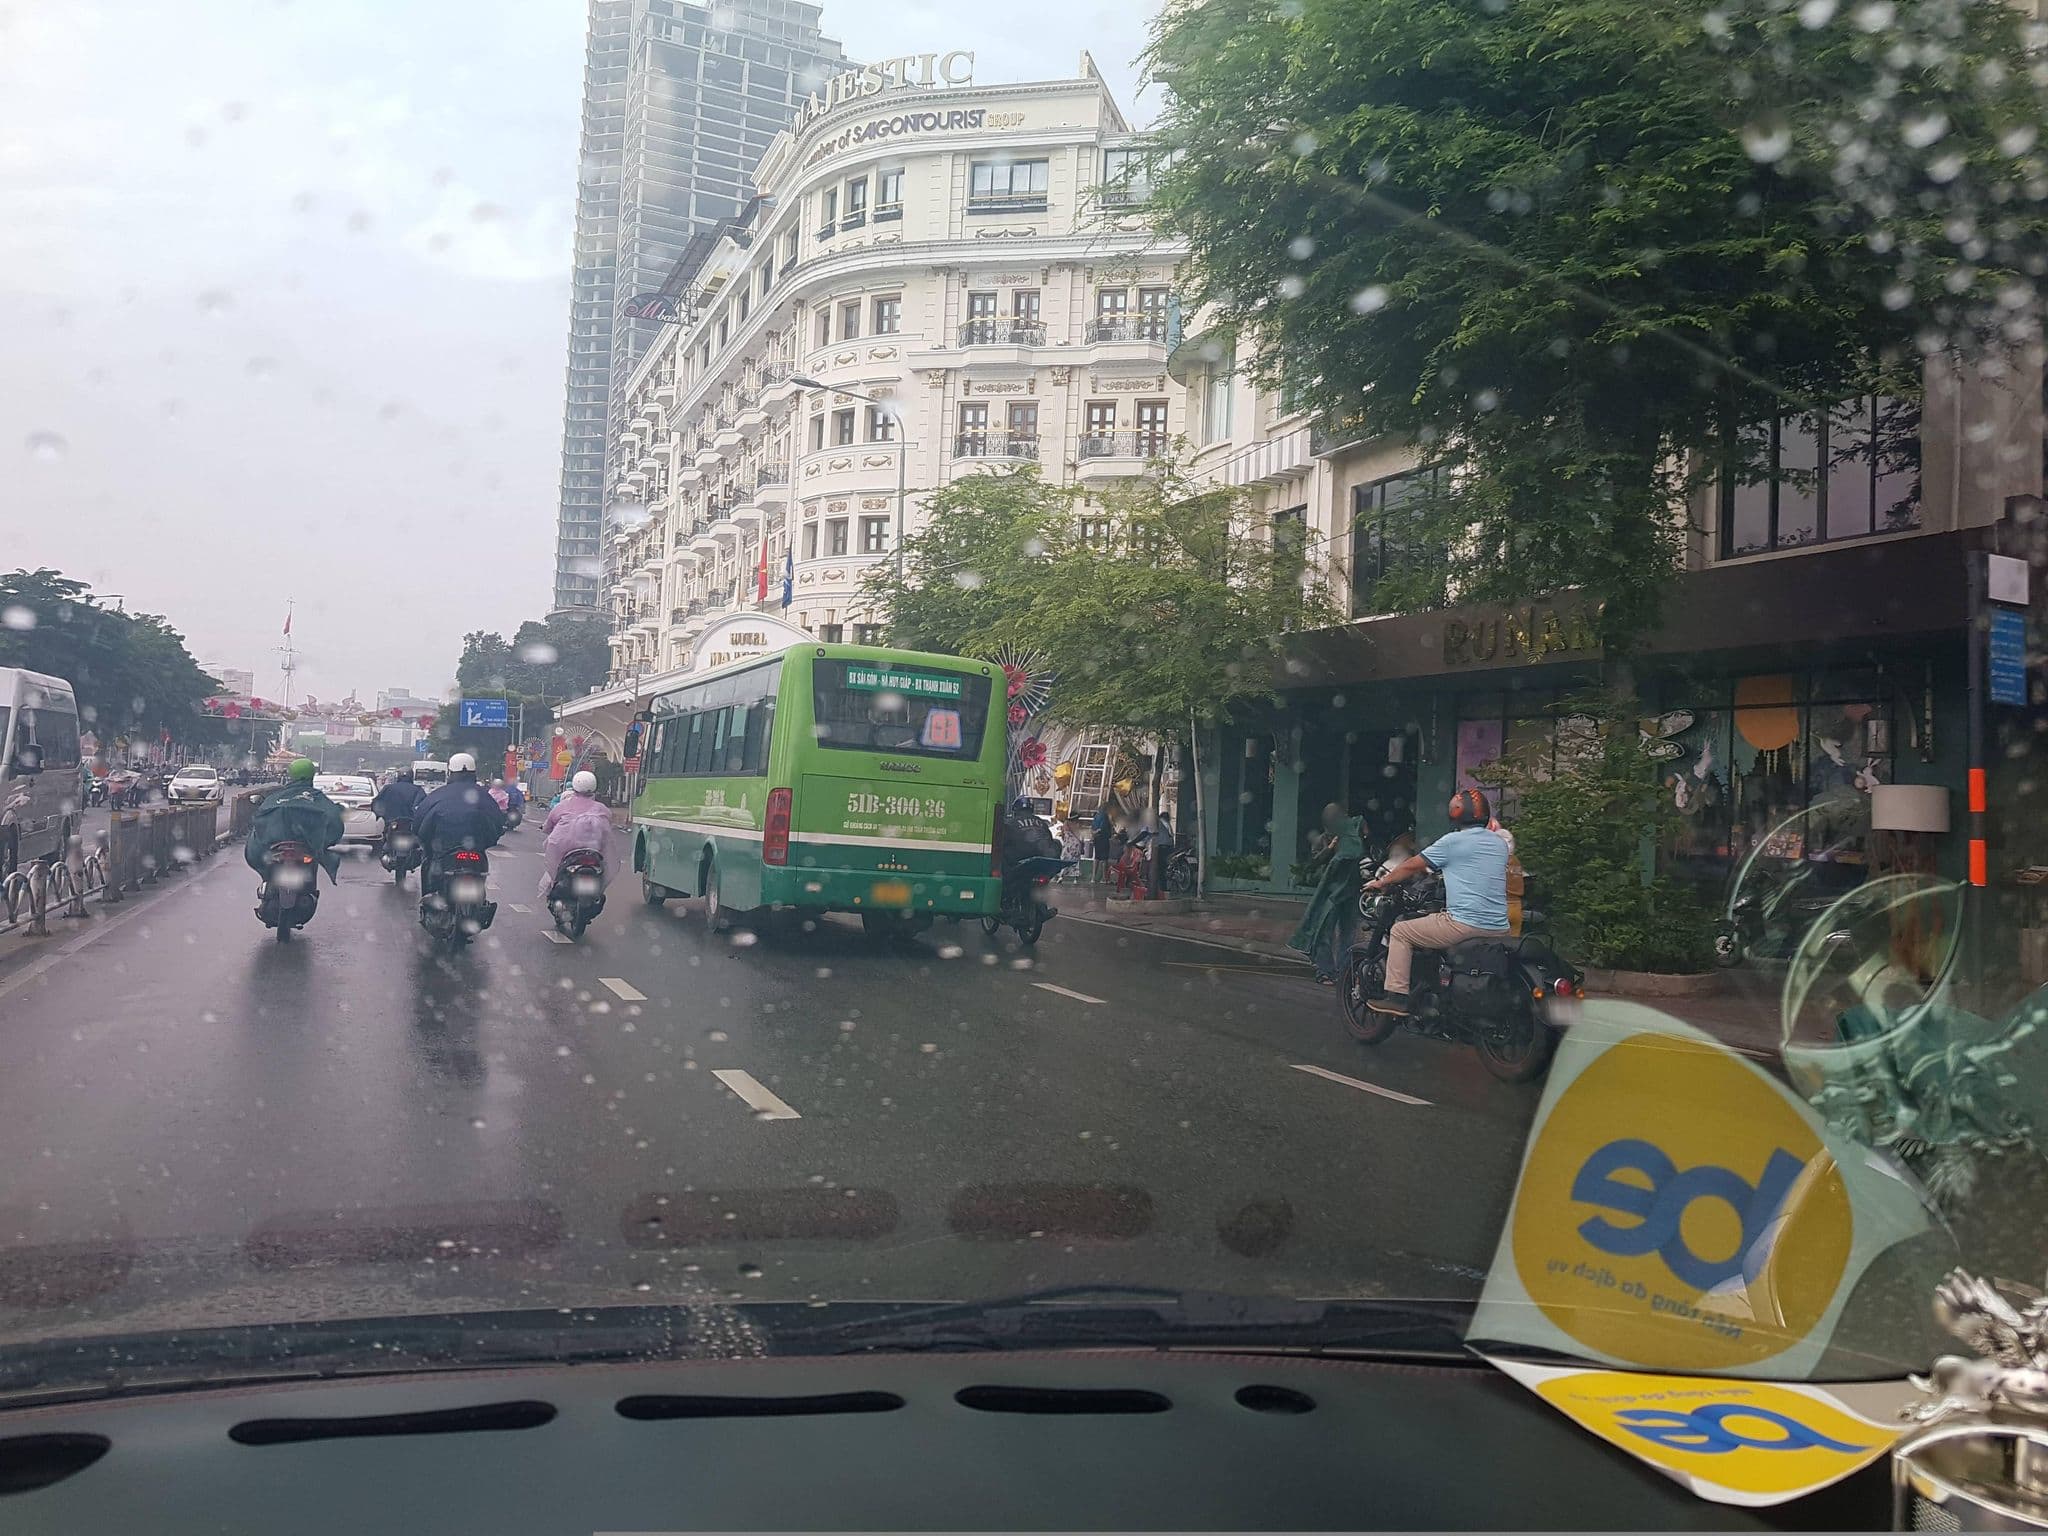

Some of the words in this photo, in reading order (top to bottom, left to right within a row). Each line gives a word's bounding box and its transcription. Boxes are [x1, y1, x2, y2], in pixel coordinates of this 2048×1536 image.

[793, 50, 974, 143] MAJESTIC
[838, 129, 851, 149] of
[853, 109, 986, 143] SAIGONTOURIST
[987, 112, 1025, 128] GROUP
[847, 793, 946, 818] 51B-300.36
